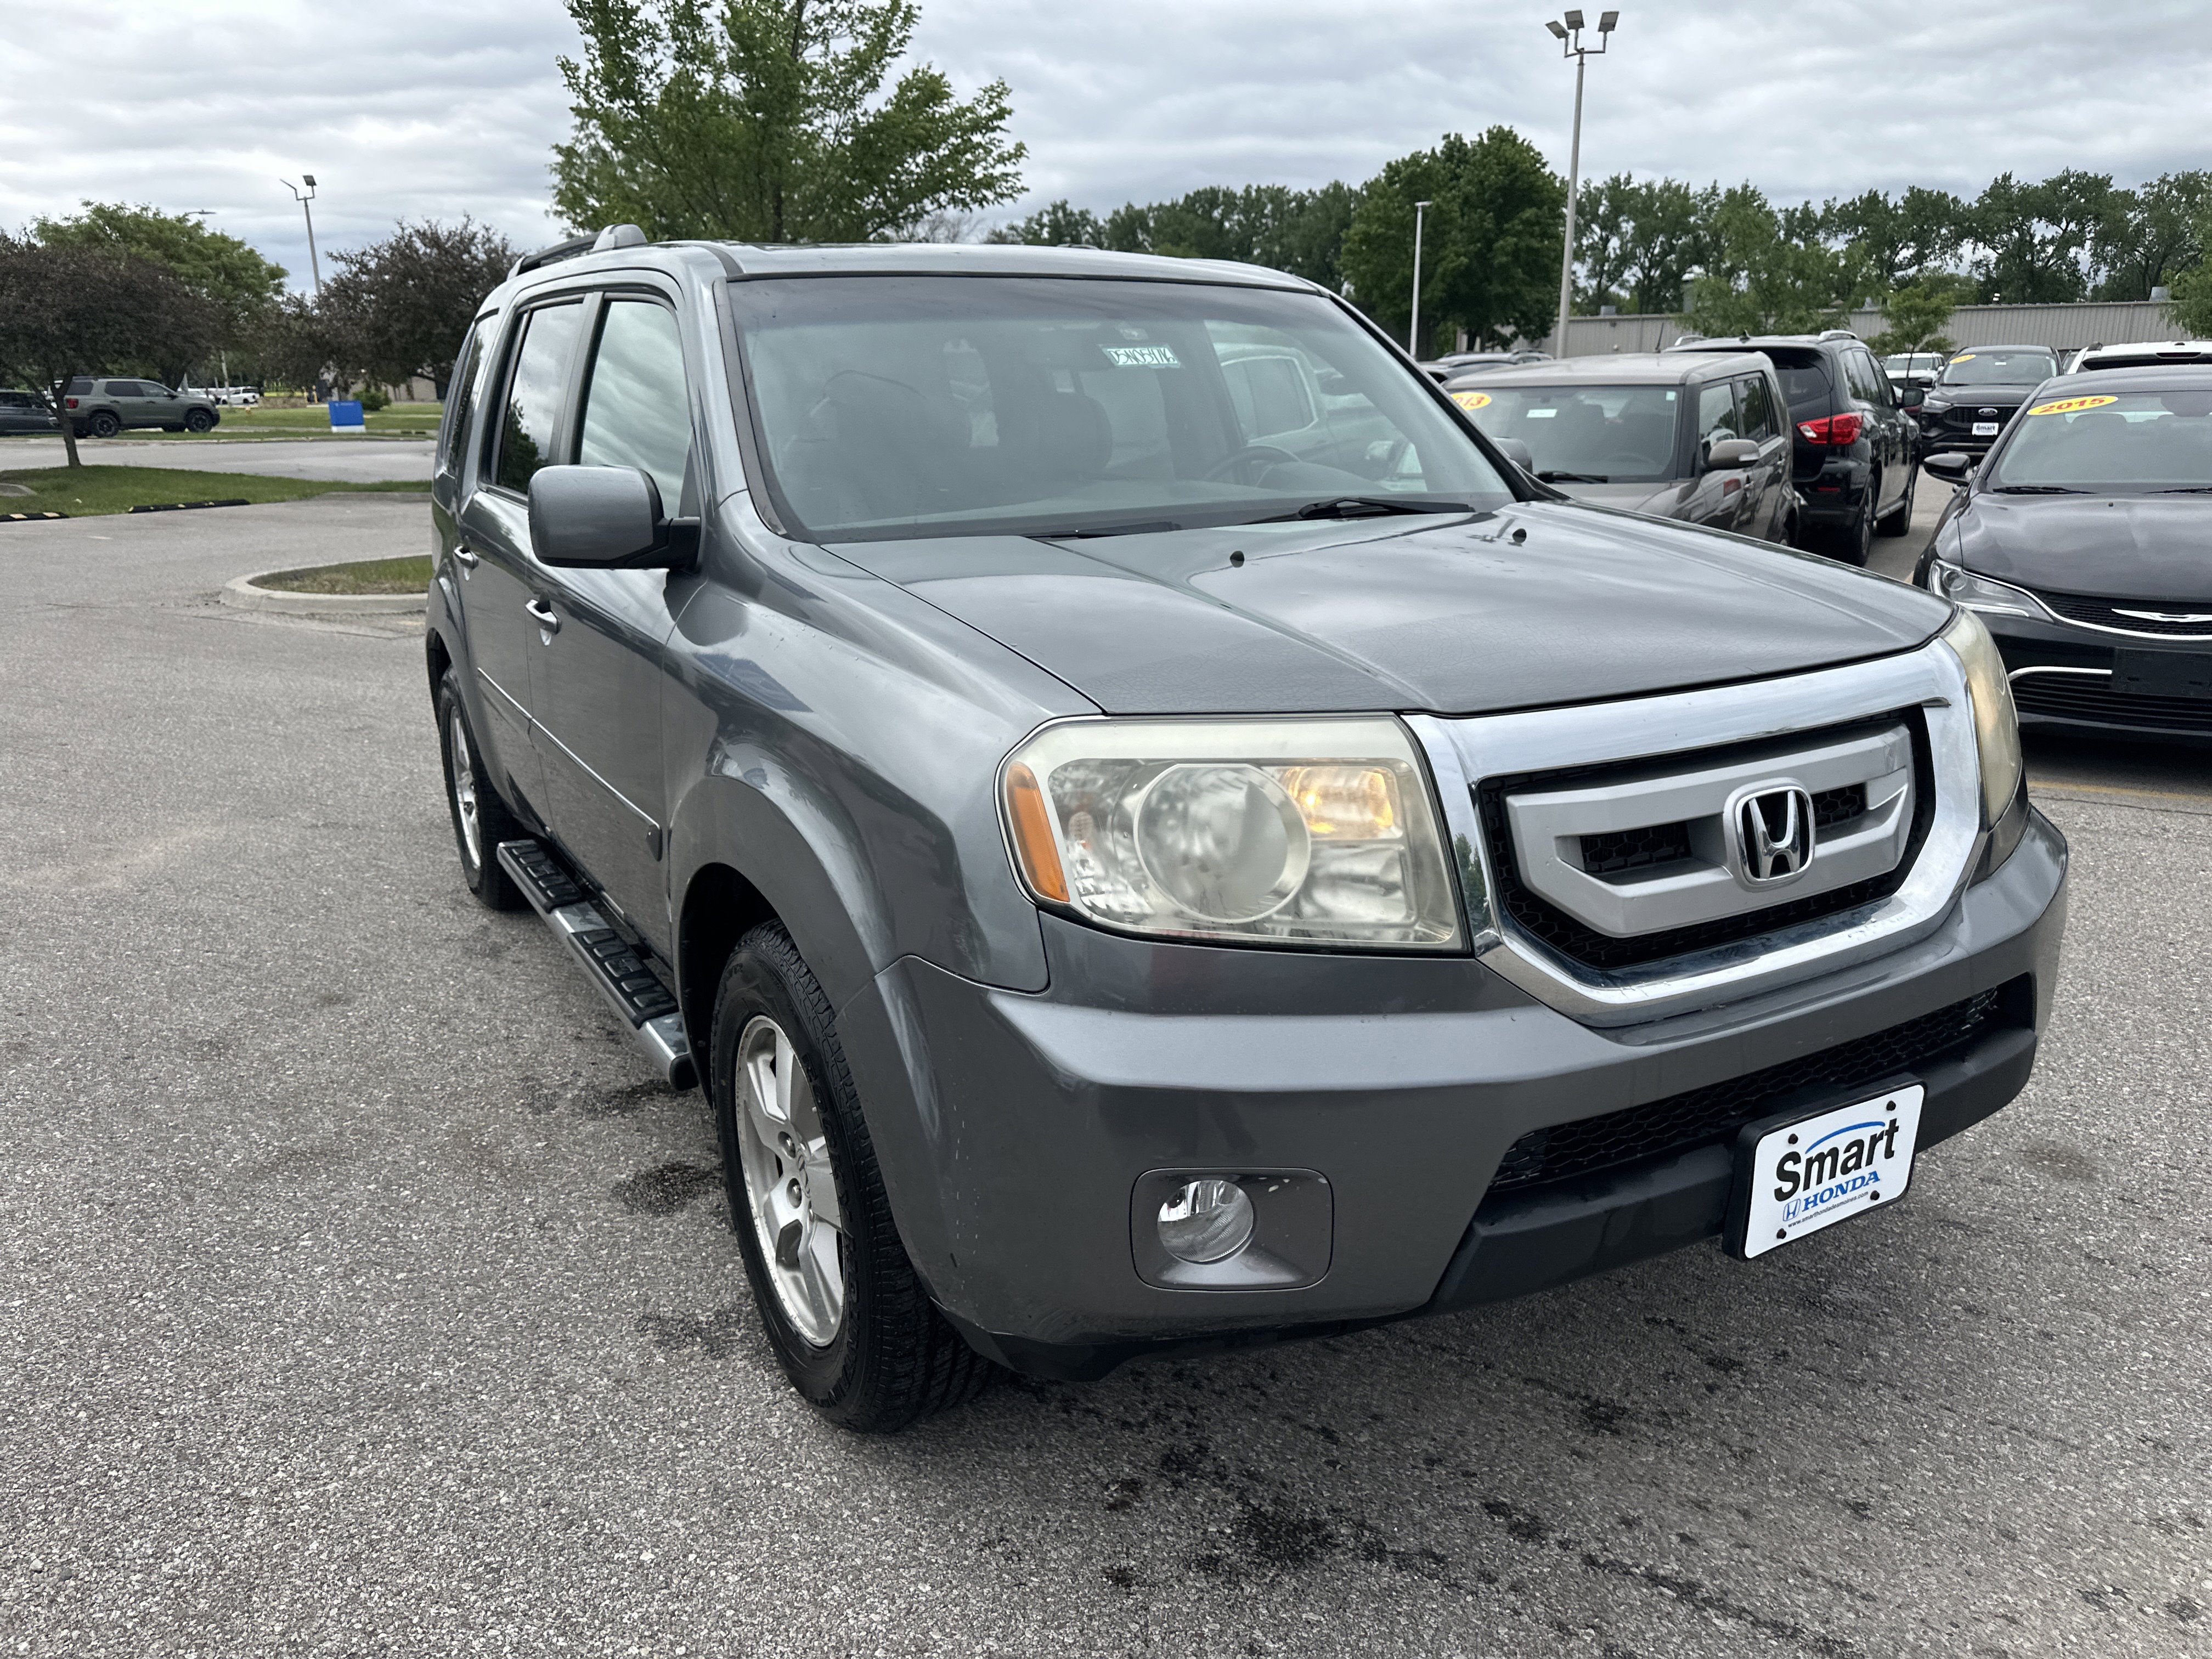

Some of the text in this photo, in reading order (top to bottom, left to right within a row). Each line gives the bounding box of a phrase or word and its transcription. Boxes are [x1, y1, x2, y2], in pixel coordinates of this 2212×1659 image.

[2039, 397, 2106, 414] 2015
[1774, 1118, 1899, 1201] Smart
[1802, 1171, 1880, 1212] HONDA
